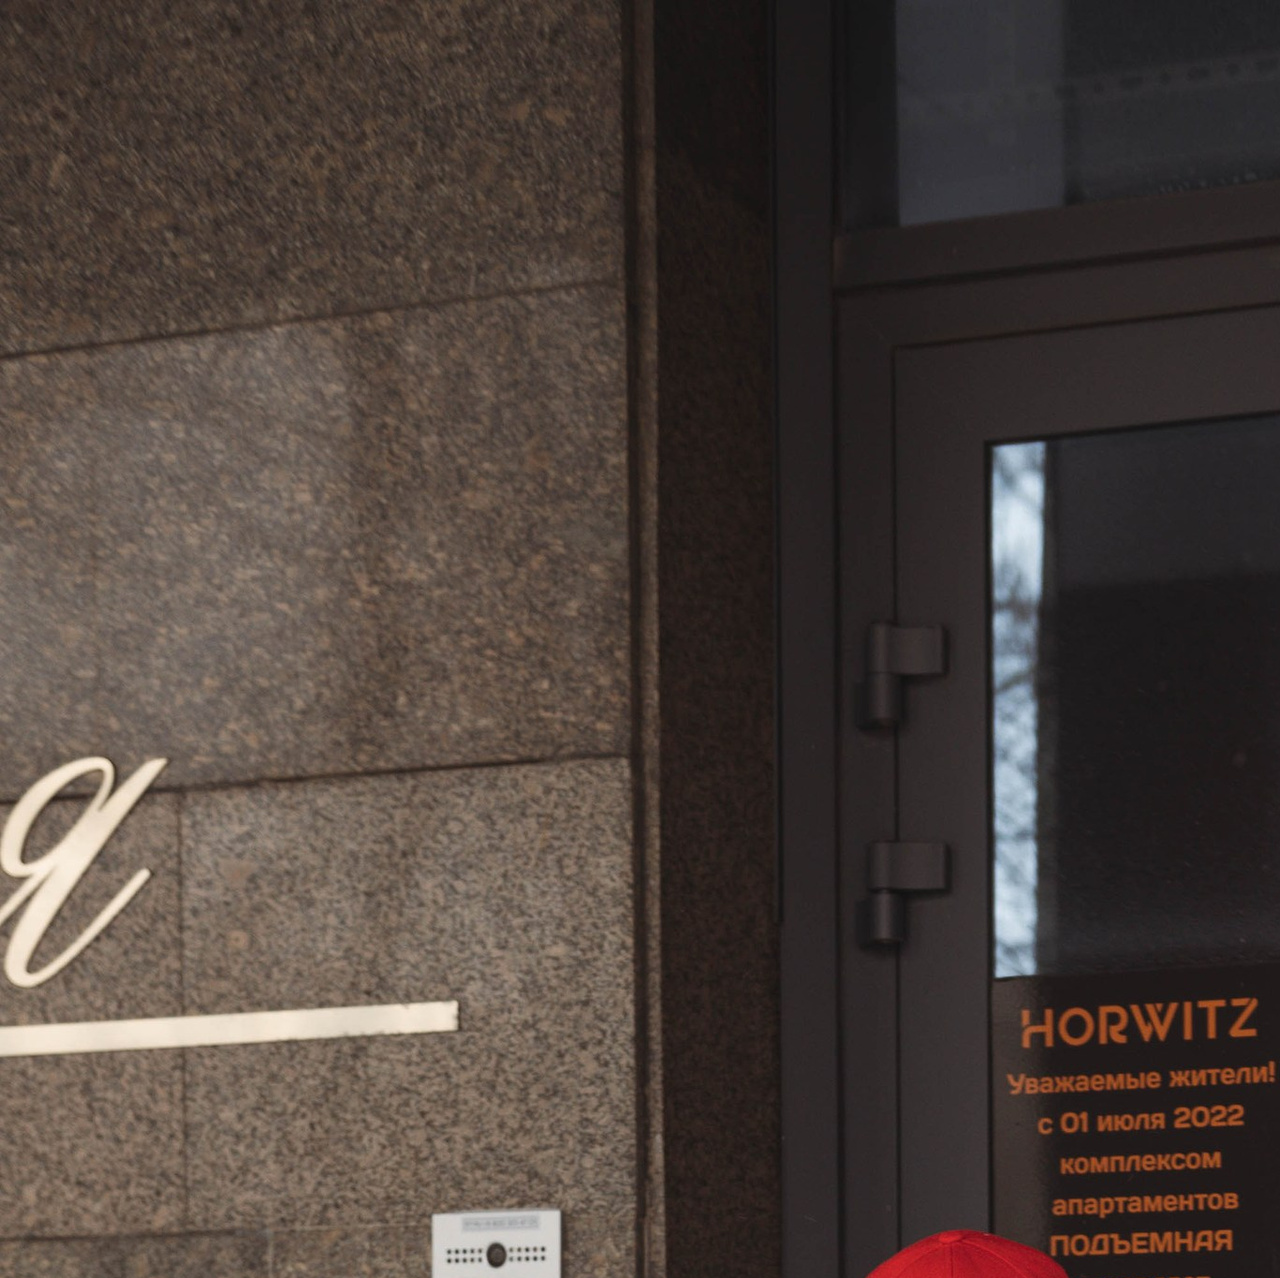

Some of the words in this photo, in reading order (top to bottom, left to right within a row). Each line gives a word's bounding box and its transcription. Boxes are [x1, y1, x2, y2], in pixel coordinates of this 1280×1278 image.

[1020, 997, 1259, 1049] HORWITZ
[1006, 1070, 1162, 1096] Уважаемые
[1169, 1060, 1276, 1089] жители!
[1037, 1117, 1053, 1135] с
[1060, 1111, 1089, 1134] 01
[1097, 1112, 1166, 1133] июля
[1173, 1104, 1245, 1129] 2022
[1059, 1151, 1222, 1176] комплексом
[1051, 1192, 1239, 1219] апартаментов
[1050, 1229, 1233, 1257] ПОДЪЕМНАЯ
